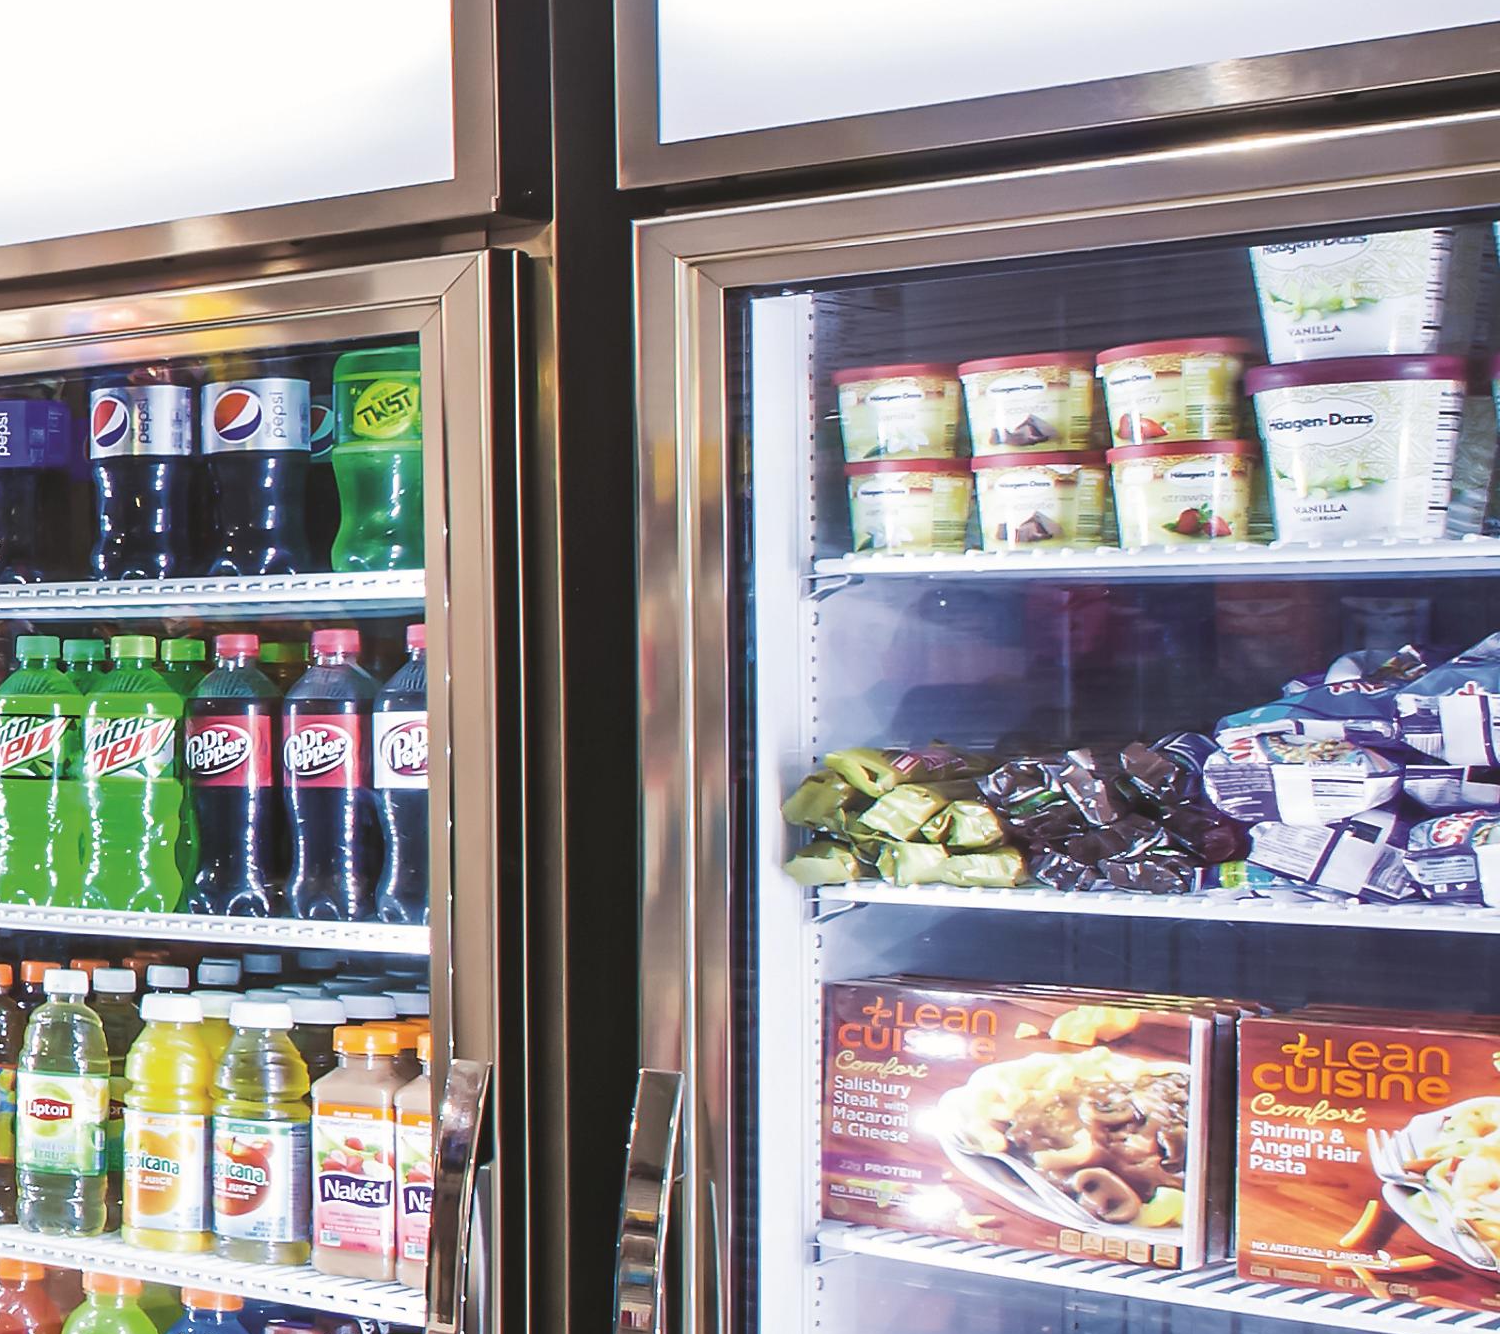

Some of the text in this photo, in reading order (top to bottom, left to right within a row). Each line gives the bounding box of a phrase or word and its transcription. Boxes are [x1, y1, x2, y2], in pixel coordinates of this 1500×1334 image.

[136, 397, 153, 445] pepsi
[269, 391, 286, 440] pepsi
[186, 733, 248, 770] Pepper
[202, 729, 228, 749] Dr
[284, 733, 346, 770] Pepper
[300, 729, 327, 749] Dr
[896, 1001, 998, 1037] Lean
[834, 1049, 929, 1079] Comfort
[1323, 1038, 1451, 1076] Lean
[834, 1074, 912, 1098] Salisbury
[27, 1099, 70, 1118] Lipton
[832, 1090, 879, 1109] Steak
[1250, 1091, 1367, 1126] Comfort
[831, 1104, 910, 1128] Macaroni
[831, 1120, 910, 1144] & Cheese
[1250, 1120, 1345, 1145] Shrimp &
[1250, 1137, 1362, 1164] Angel Hair
[864, 1163, 923, 1180] PROTEIN
[1249, 1155, 1307, 1175] Pasta
[323, 1178, 390, 1205] Naked
[1251, 1241, 1267, 1251] NO
[1269, 1242, 1325, 1259] ARTIFICIAL
